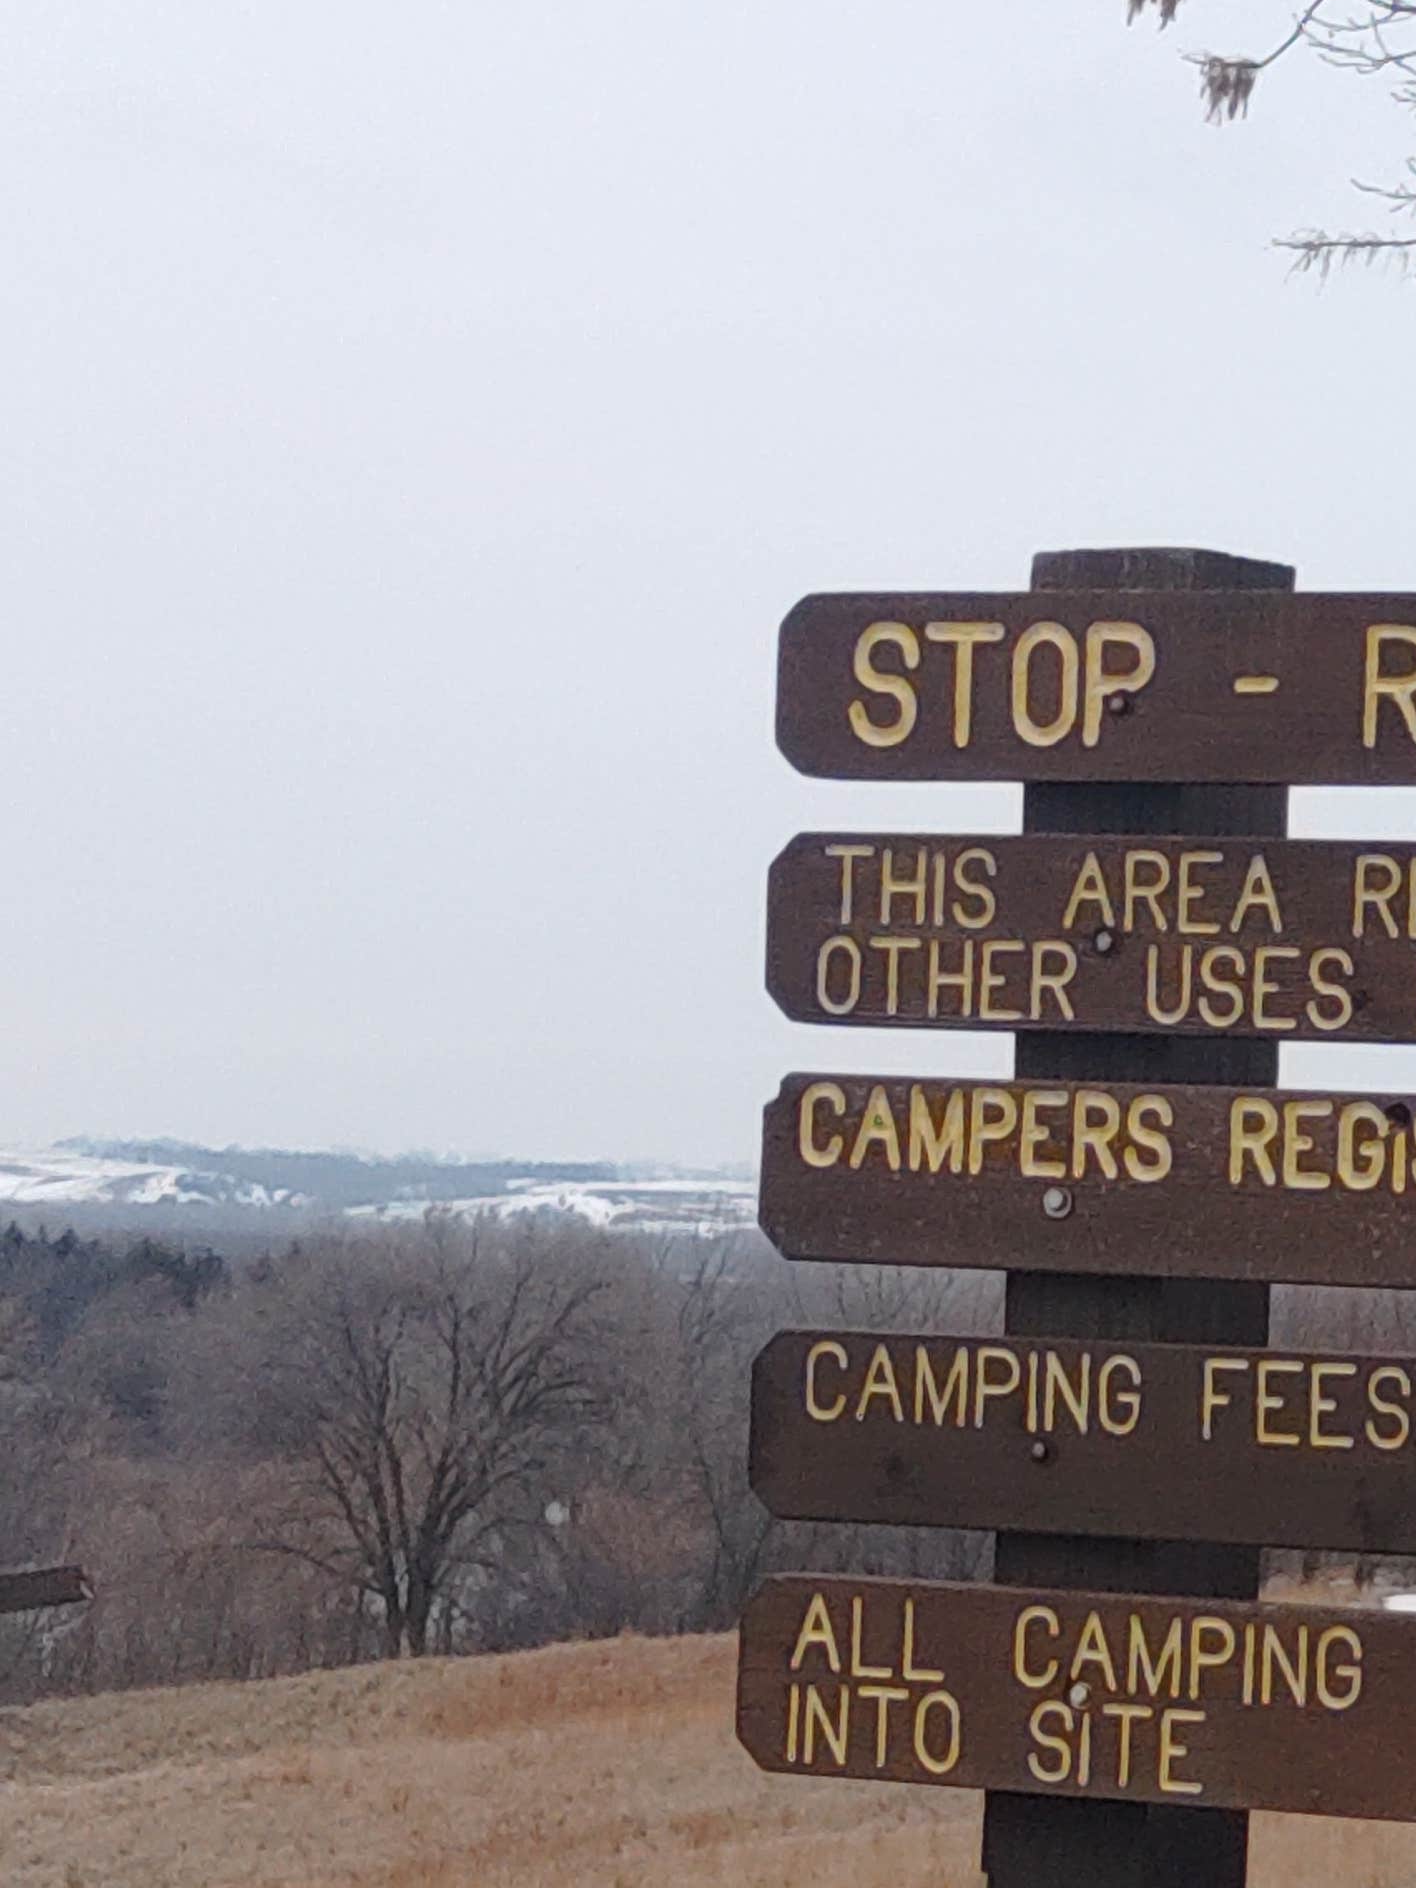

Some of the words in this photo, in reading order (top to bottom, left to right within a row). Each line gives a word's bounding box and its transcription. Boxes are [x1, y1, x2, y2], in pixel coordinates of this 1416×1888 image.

[846, 620, 1157, 750] STOP
[831, 844, 997, 930] THIS
[1062, 849, 1284, 935] AREA
[817, 934, 1078, 1022] OTHER
[1145, 943, 1355, 1032] USES
[798, 1081, 1174, 1184] CAMPERS
[805, 1340, 1143, 1436] CAMPING
[790, 1592, 946, 1683] ALL
[1014, 1605, 1363, 1711] CAMPING
[785, 1683, 961, 1775] INTO
[1027, 1699, 1207, 1796] SITE
